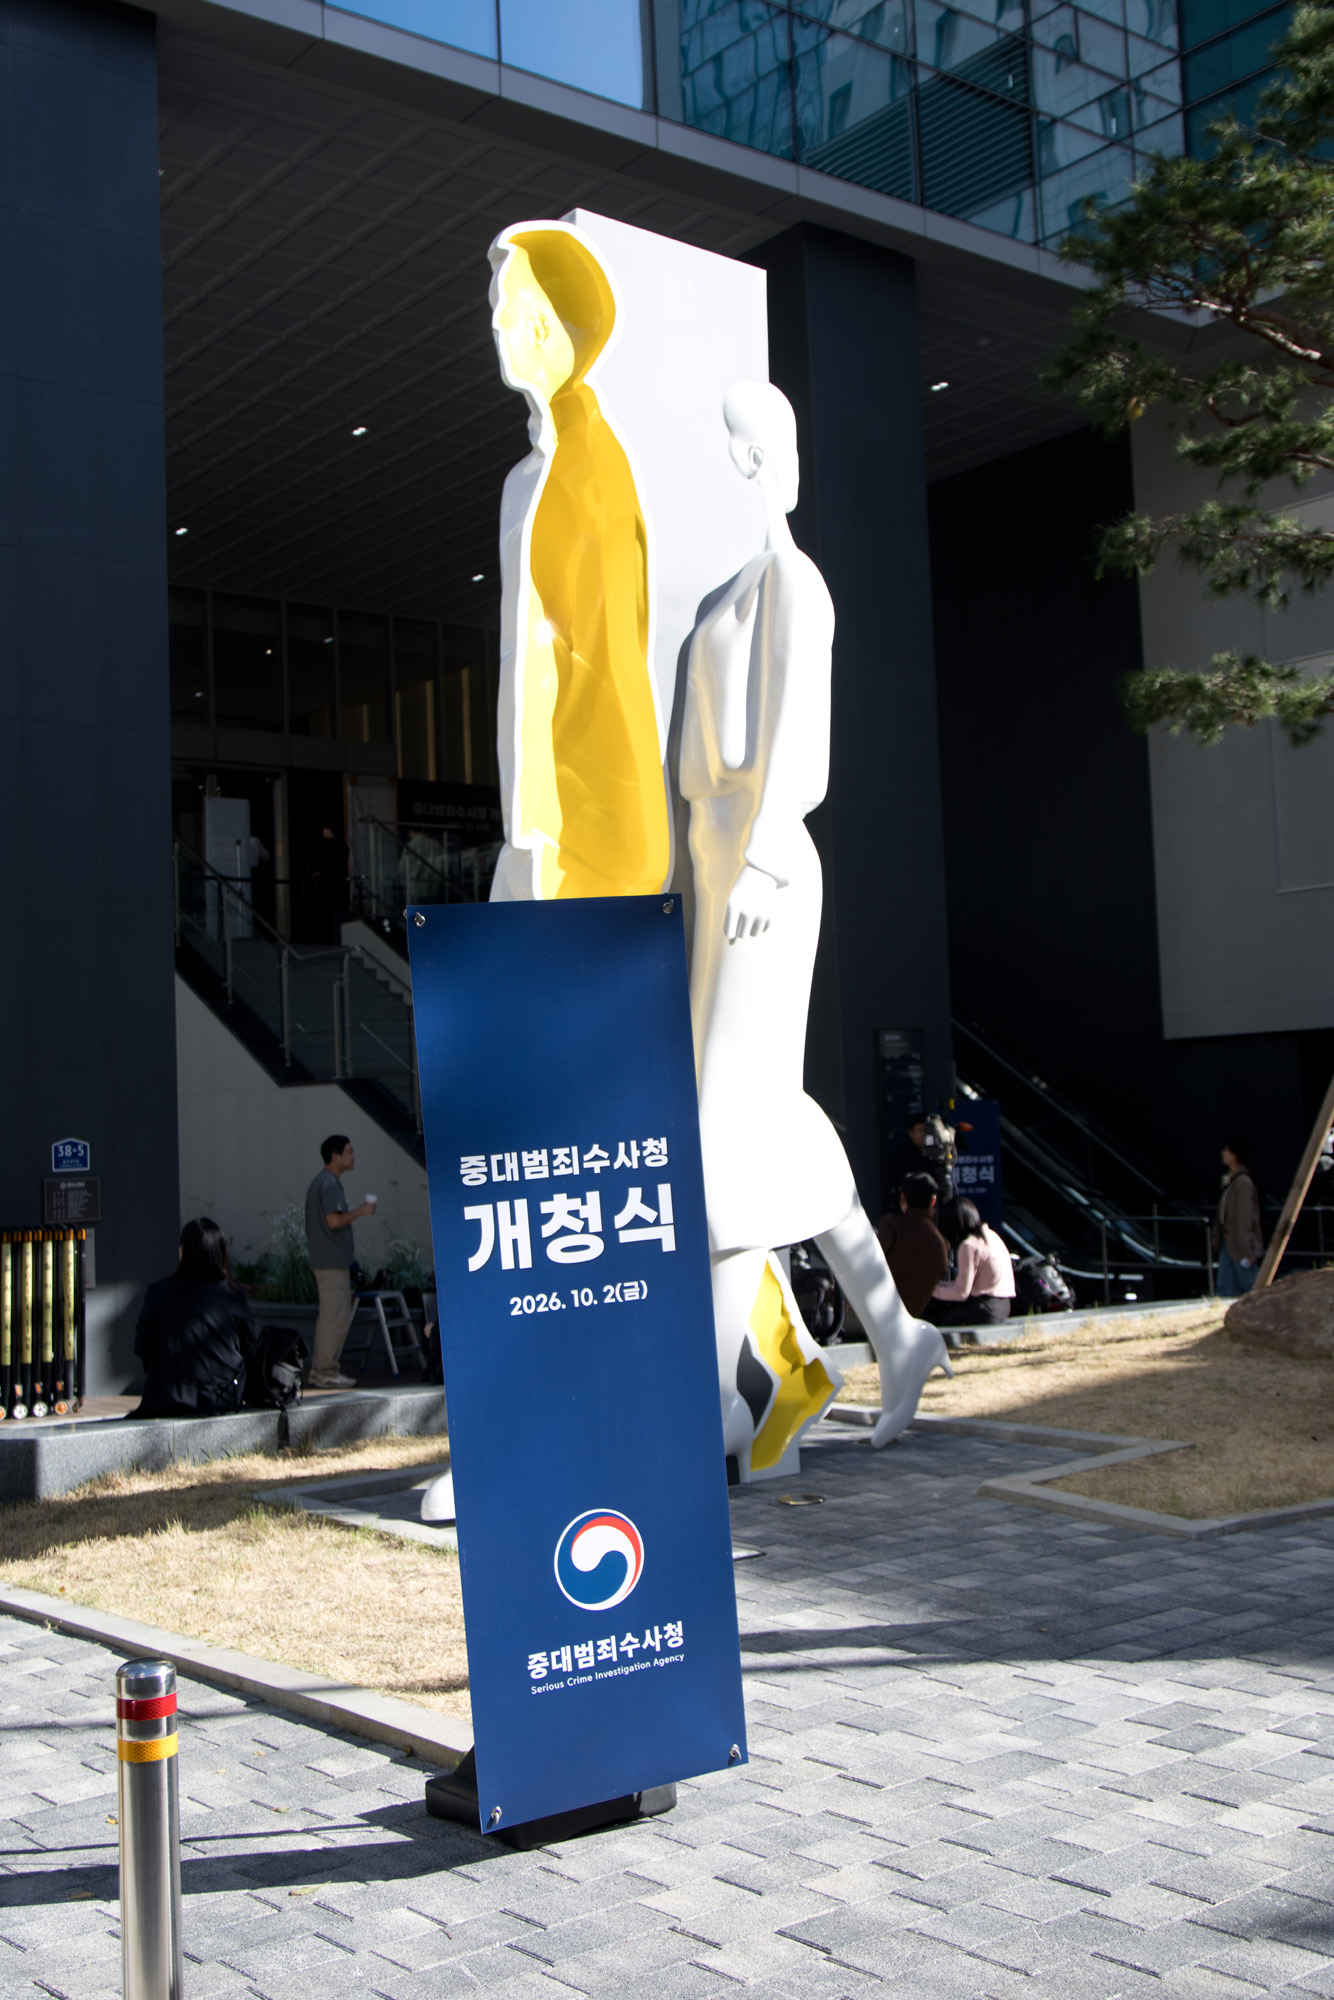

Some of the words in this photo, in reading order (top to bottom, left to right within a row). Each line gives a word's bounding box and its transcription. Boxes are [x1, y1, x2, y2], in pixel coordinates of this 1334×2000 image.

[57, 1144, 84, 1158] 38-5
[460, 1137, 669, 1186] 중대범죄수사청
[463, 1183, 676, 1273] 개청식
[510, 1292, 567, 1316] 2026.
[571, 1287, 598, 1308] 10.
[603, 1280, 648, 1304] 2(금)
[527, 1620, 684, 1680] 중대범죄수사청
[531, 1679, 565, 1695] Serious
[567, 1672, 593, 1687] Crime
[595, 1660, 651, 1680] Investigation
[653, 1653, 685, 1668] Agency
